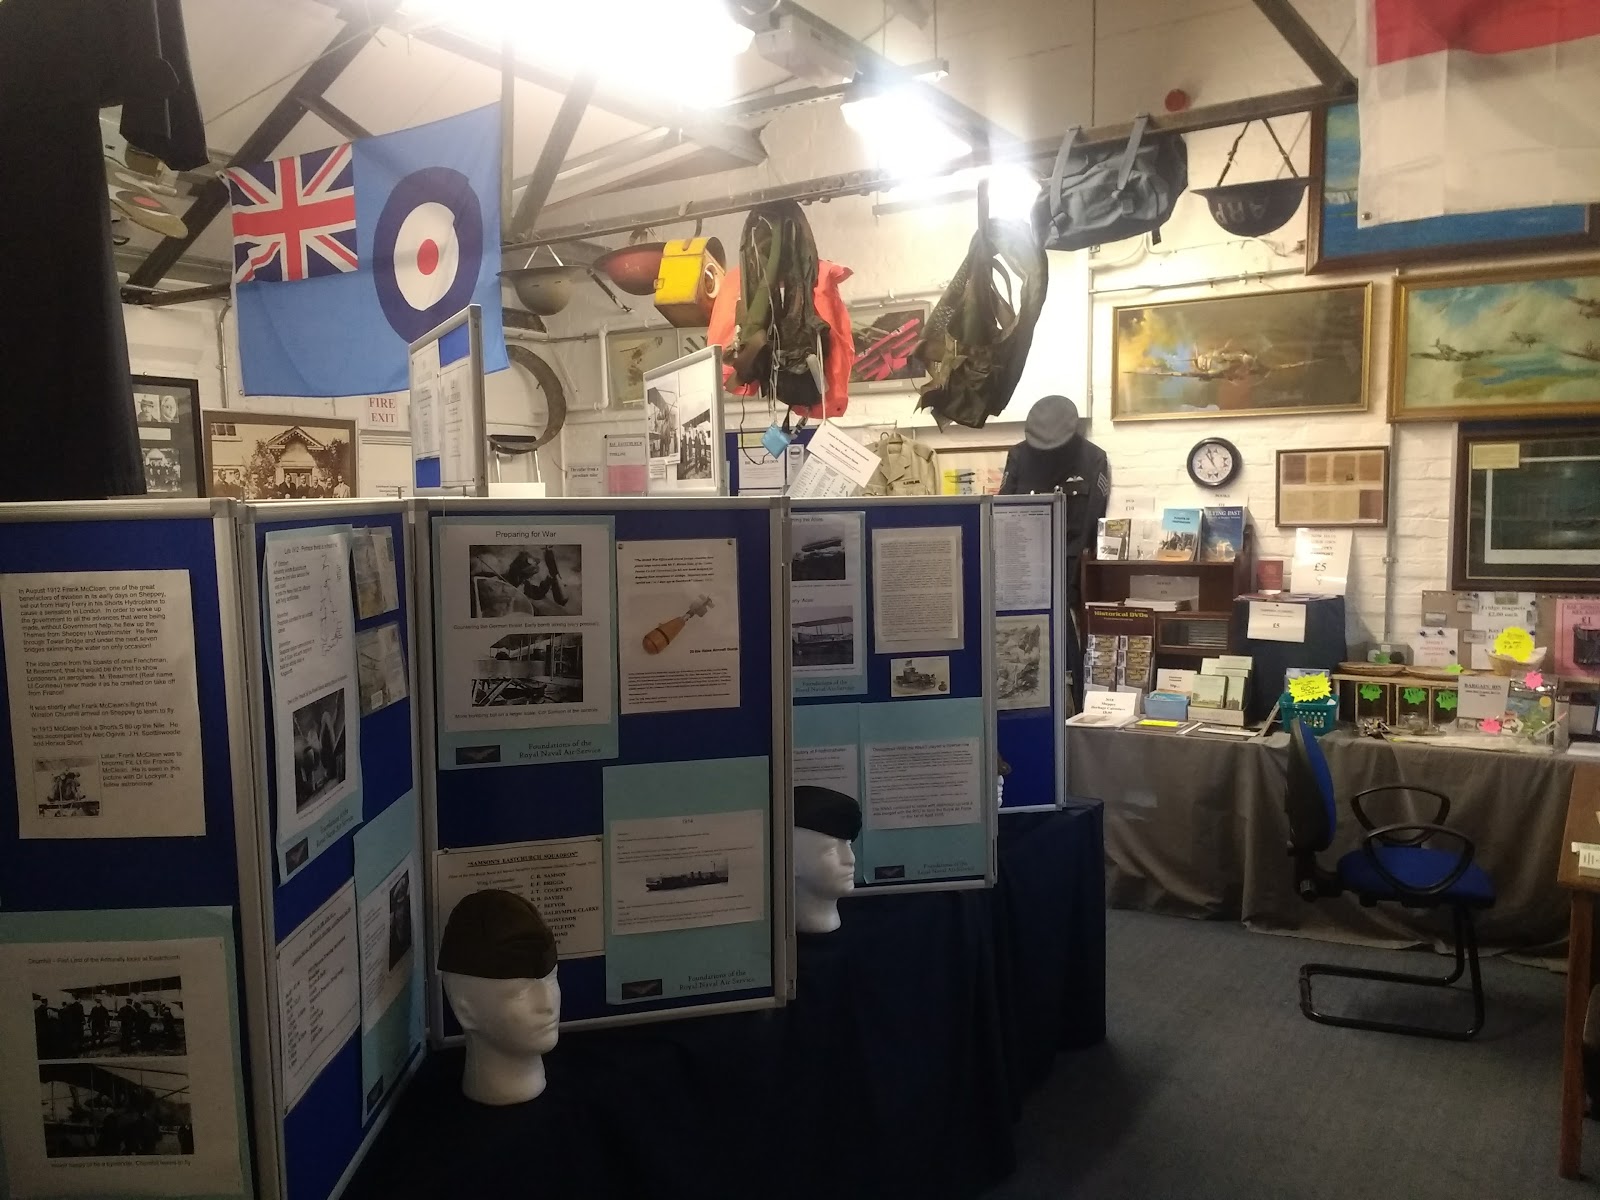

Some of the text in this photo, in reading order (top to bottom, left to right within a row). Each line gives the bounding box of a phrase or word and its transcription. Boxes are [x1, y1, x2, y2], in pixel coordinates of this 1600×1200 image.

[369, 397, 396, 409] FIRE
[371, 412, 396, 423] EXIT
[1227, 509, 1242, 517] PAST
[496, 531, 530, 539] Preparing
[1313, 562, 1327, 572] £5
[529, 741, 571, 750] Foundations
[520, 751, 539, 760] Royal
[540, 749, 562, 757] Naval
[575, 747, 601, 755] Service
[502, 857, 542, 865] EASTCHURCH
[688, 972, 727, 982] Foundations
[680, 983, 698, 992] Royal
[731, 977, 755, 985] Service
